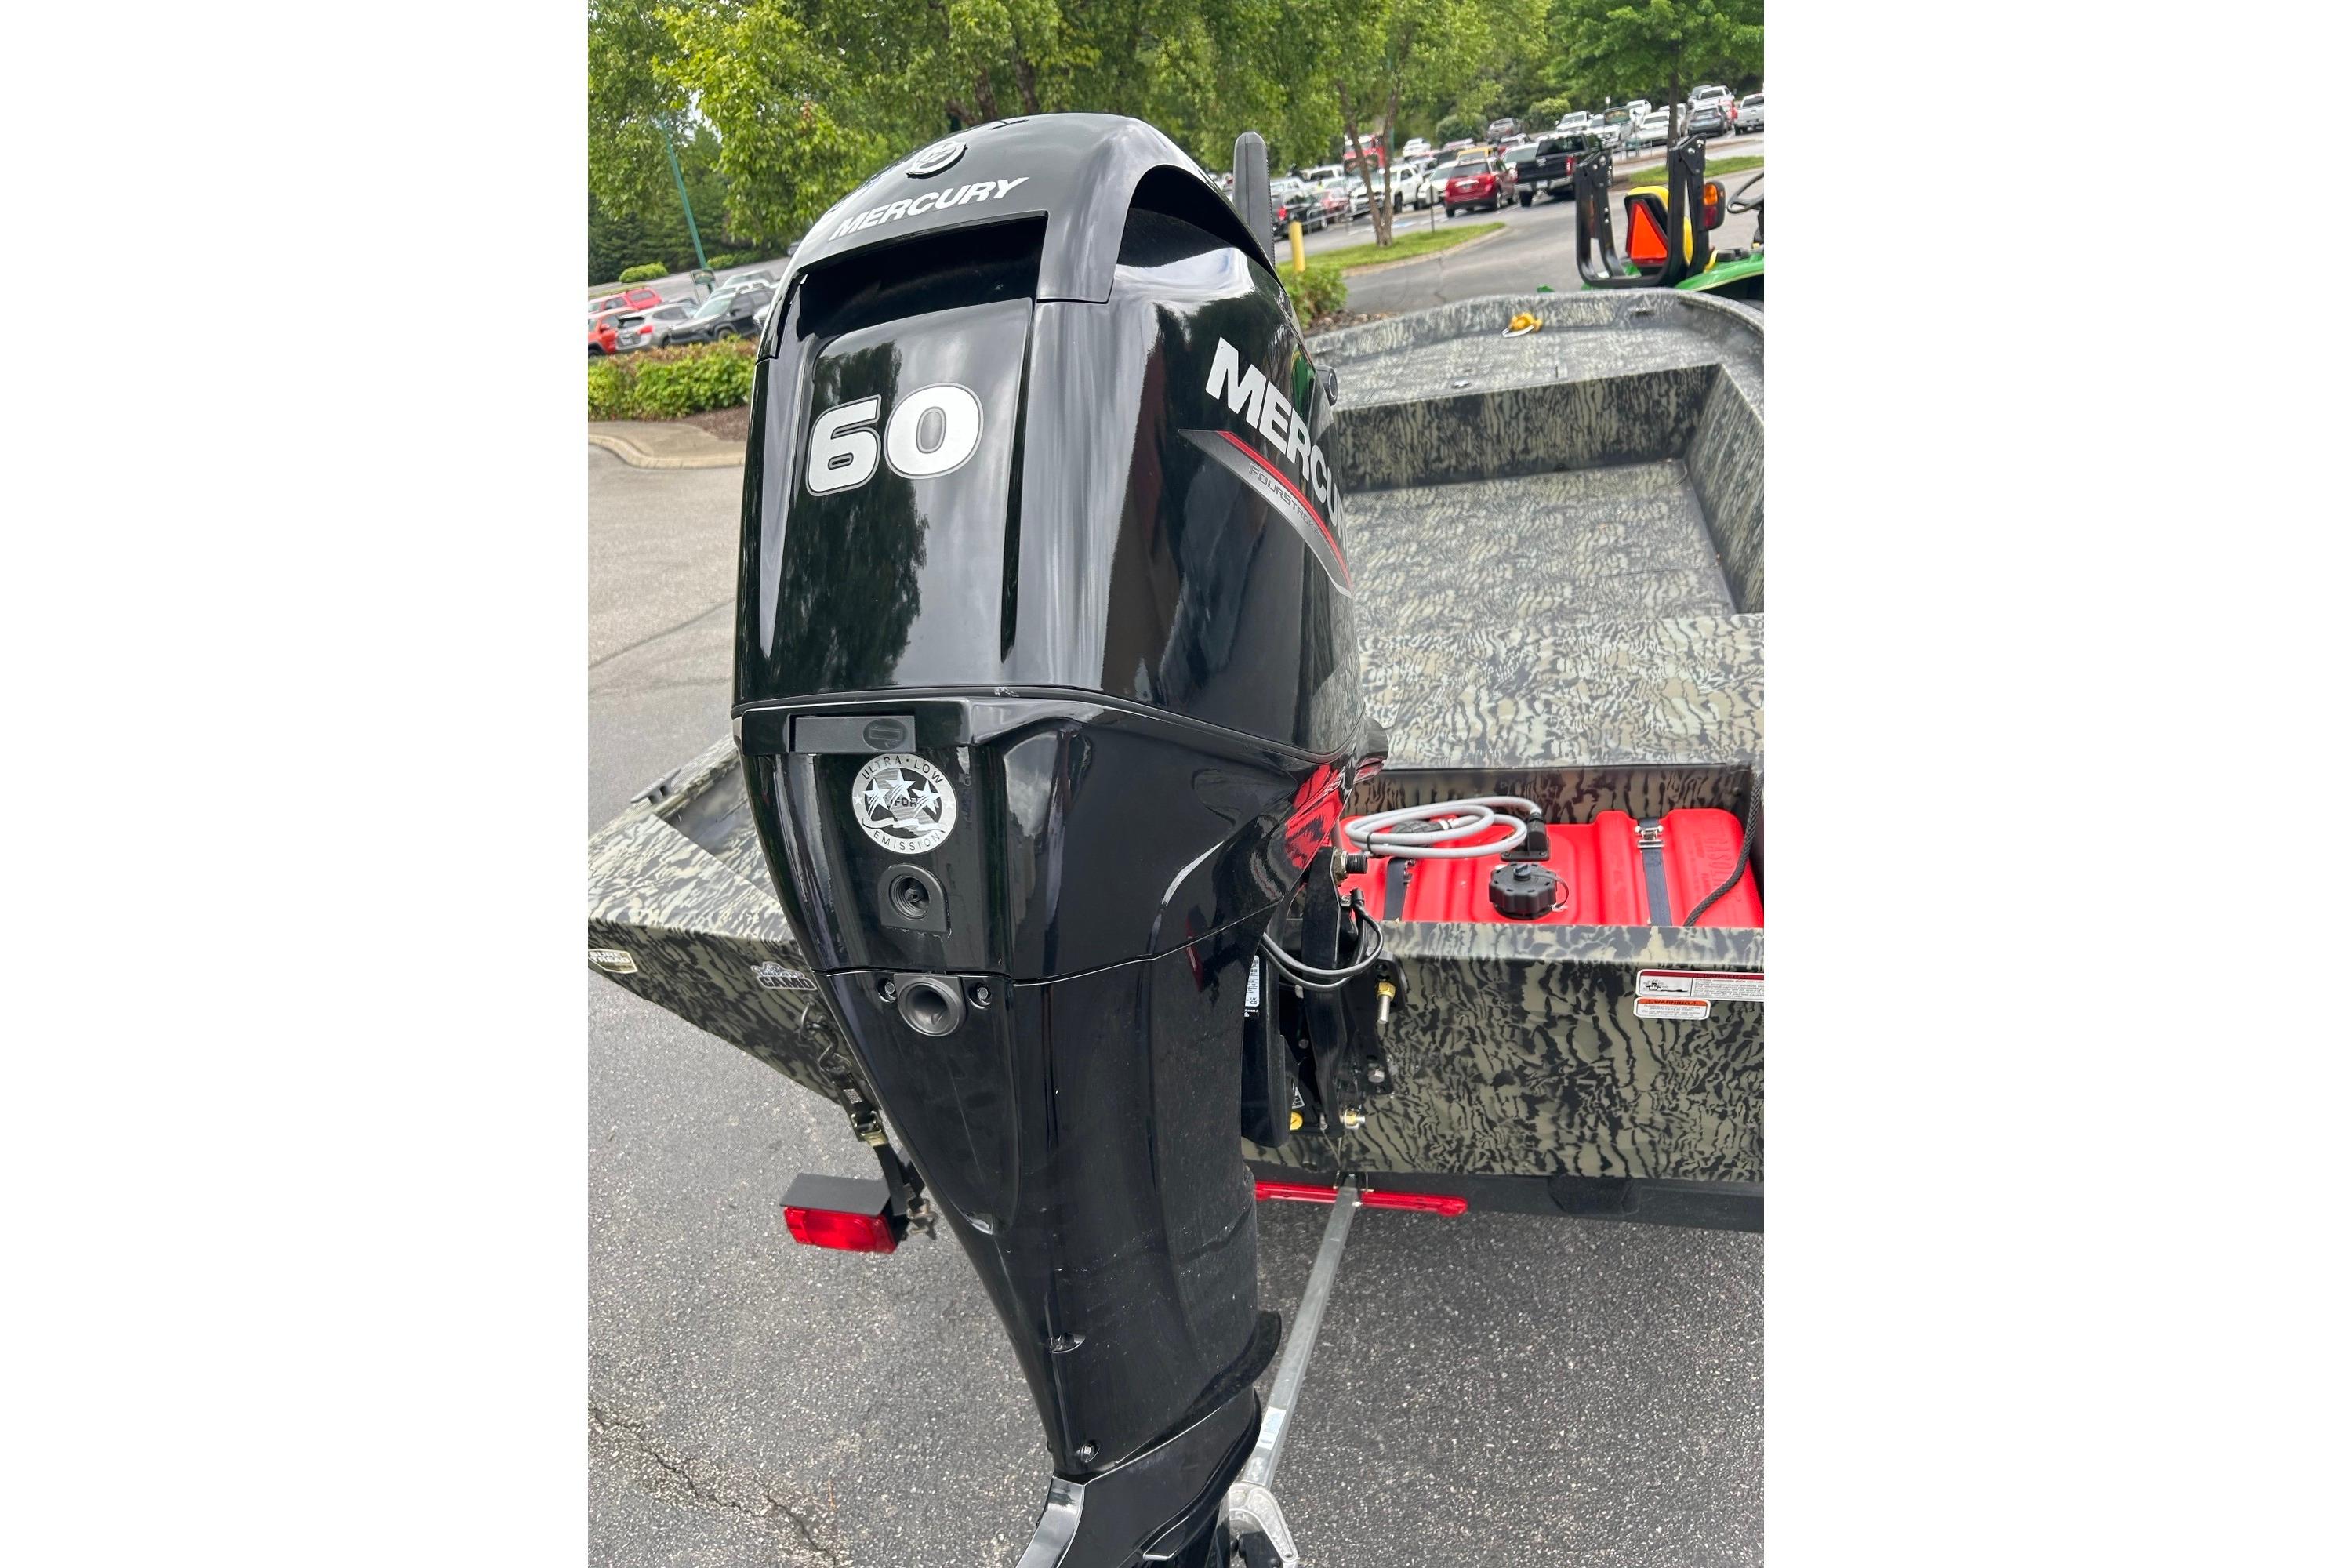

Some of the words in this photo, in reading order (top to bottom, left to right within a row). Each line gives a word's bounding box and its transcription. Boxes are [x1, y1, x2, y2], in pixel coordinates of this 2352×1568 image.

[829, 177, 1029, 241] MERCURY
[805, 382, 984, 497] 60
[1248, 462, 1320, 535] FOURSTROKE
[862, 755, 902, 779] ULTRA
[914, 760, 944, 784] LOW
[873, 830, 940, 851] EMISSION
[759, 977, 815, 989] CAMO
